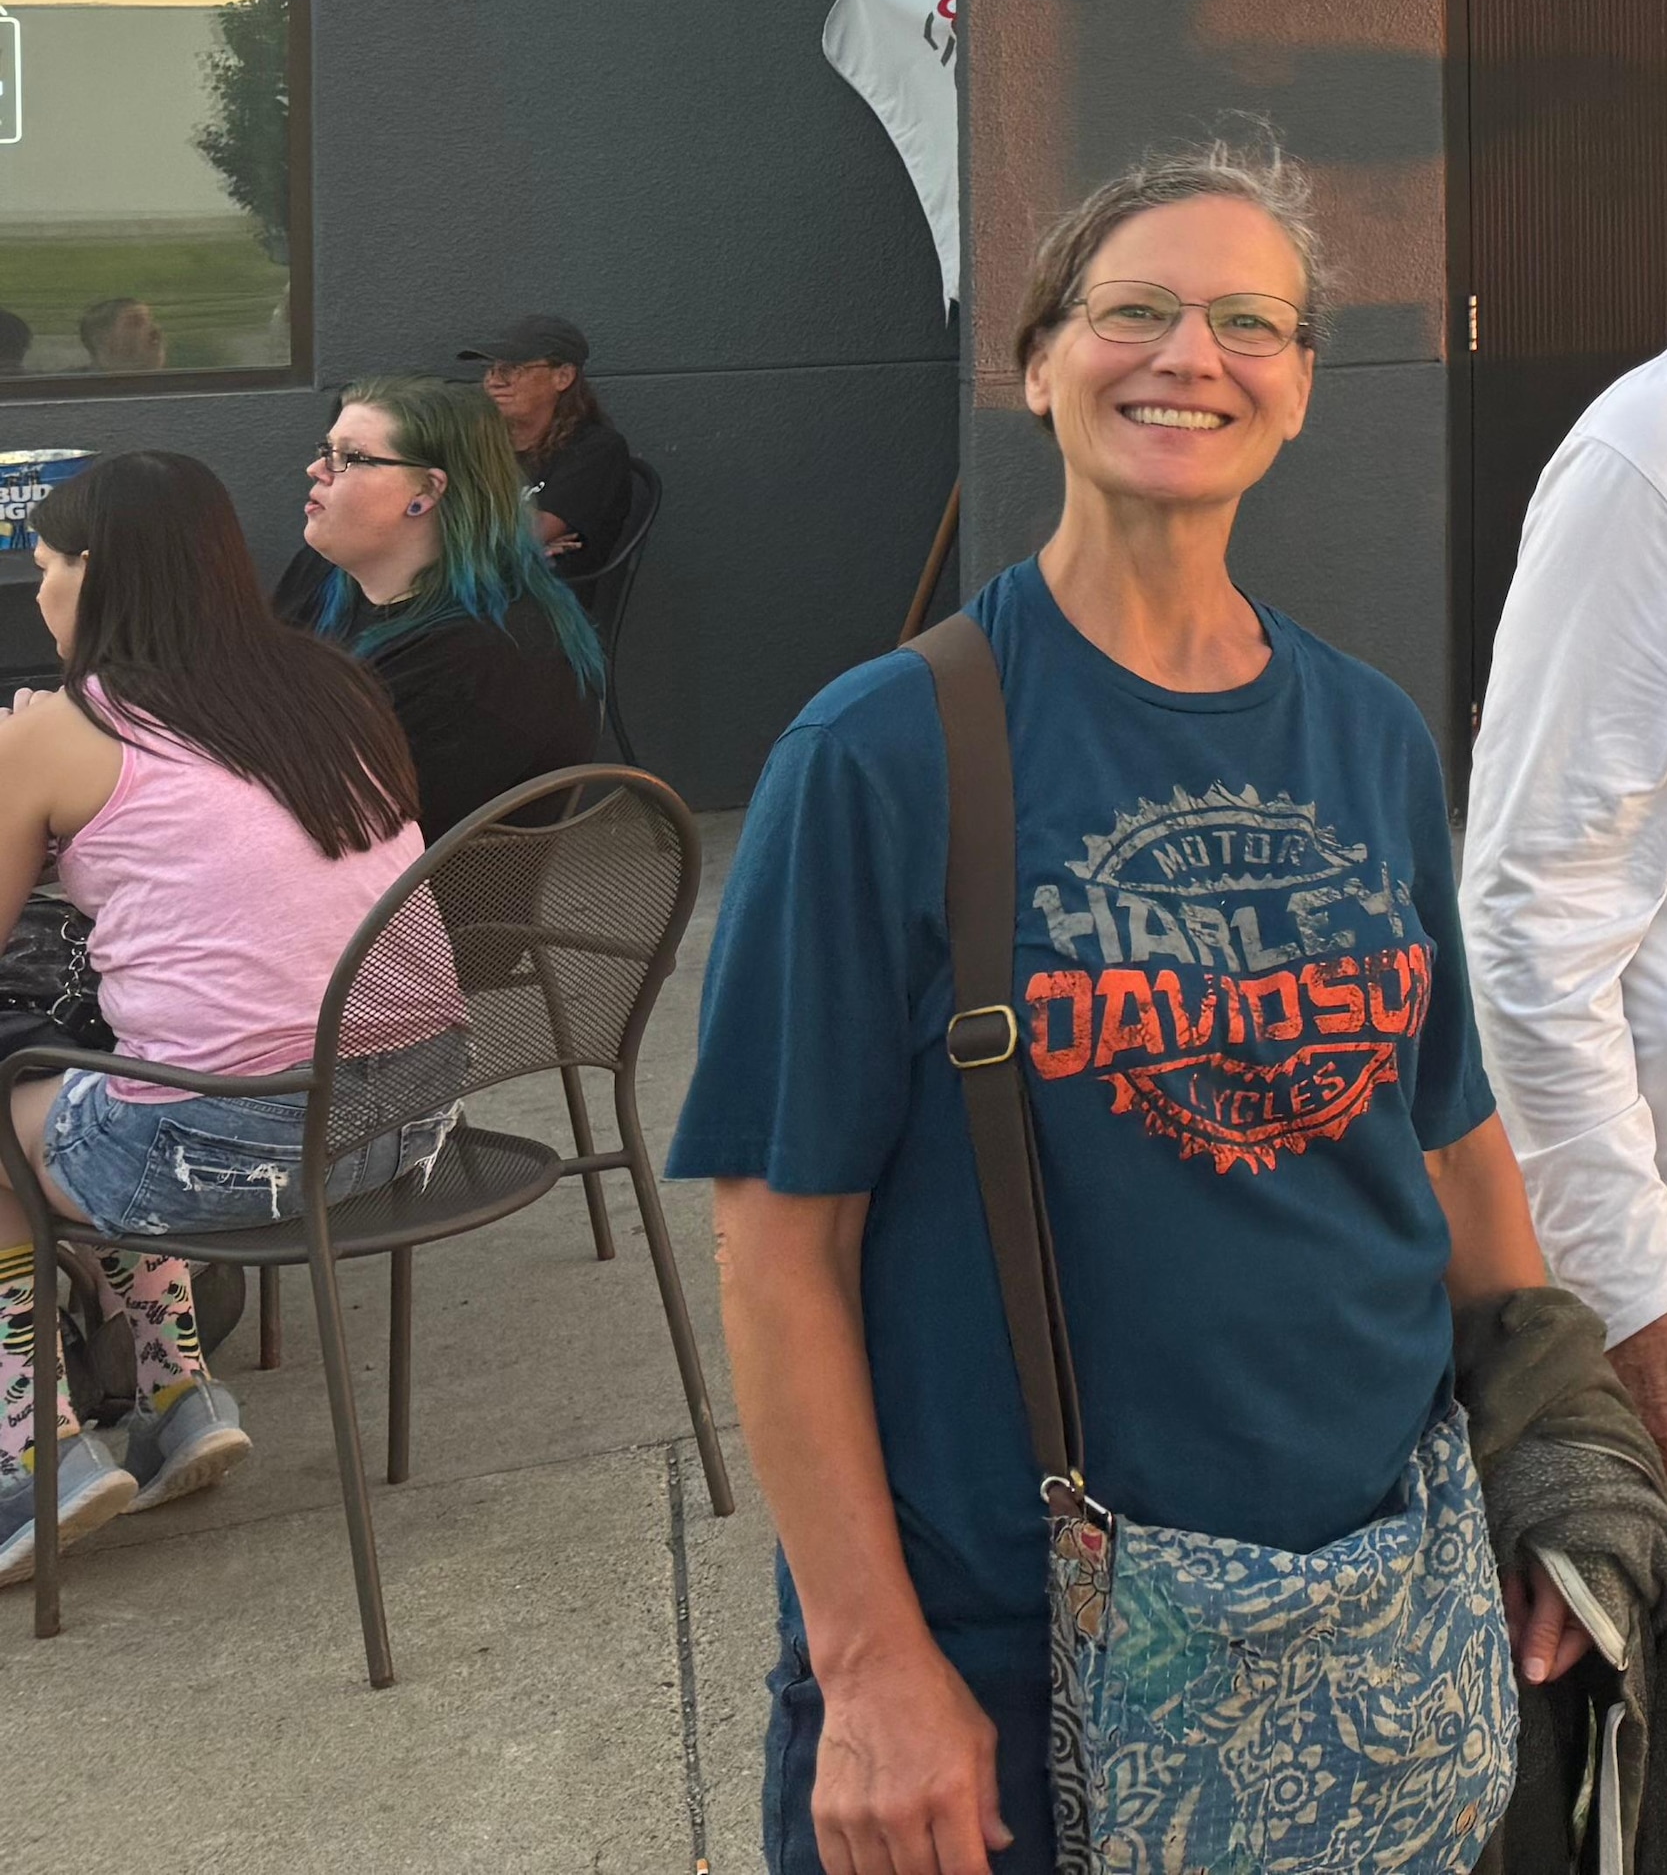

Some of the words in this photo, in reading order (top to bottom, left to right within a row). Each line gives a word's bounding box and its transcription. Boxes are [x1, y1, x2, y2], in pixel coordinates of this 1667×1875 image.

[1151, 830, 1306, 880] MOTOR
[1031, 861, 1411, 973] HARLEY
[1188, 1061, 1347, 1126] CYCLES
